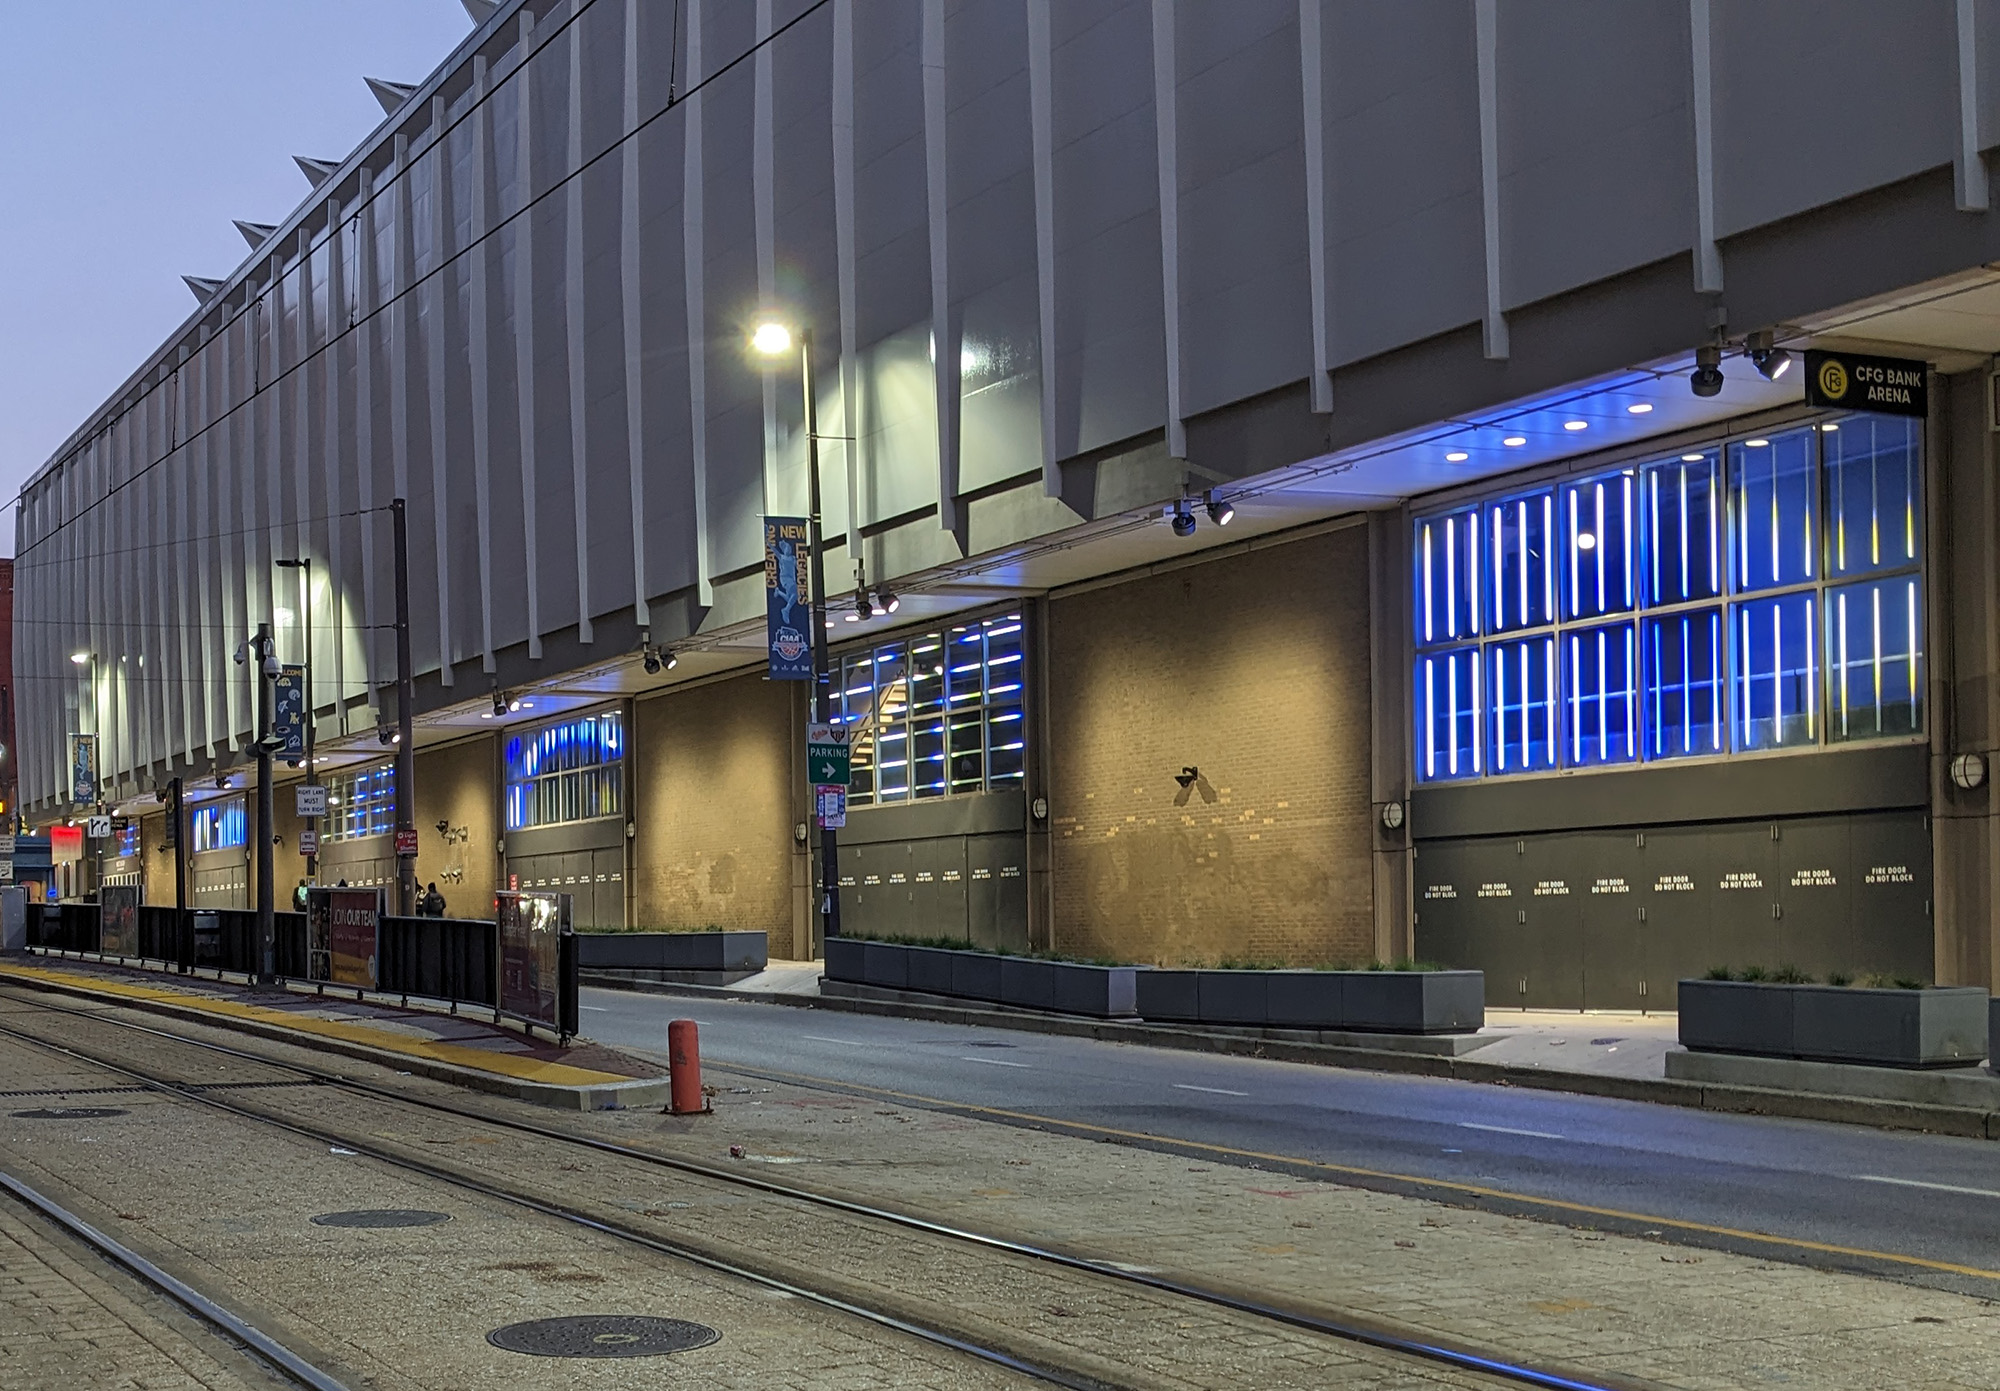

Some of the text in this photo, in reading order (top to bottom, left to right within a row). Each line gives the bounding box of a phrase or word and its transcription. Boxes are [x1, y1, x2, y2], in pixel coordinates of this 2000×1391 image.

[1856, 366, 1921, 388] CFG BANK
[1868, 386, 1911, 404] ARENA
[780, 525, 806, 539] NEW
[796, 543, 808, 606] LEGACIES
[810, 748, 848, 758] PARKING
[1888, 866, 1906, 874] DOOR
[1892, 874, 1913, 882] BLOCK
[347, 909, 360, 926] OUR
